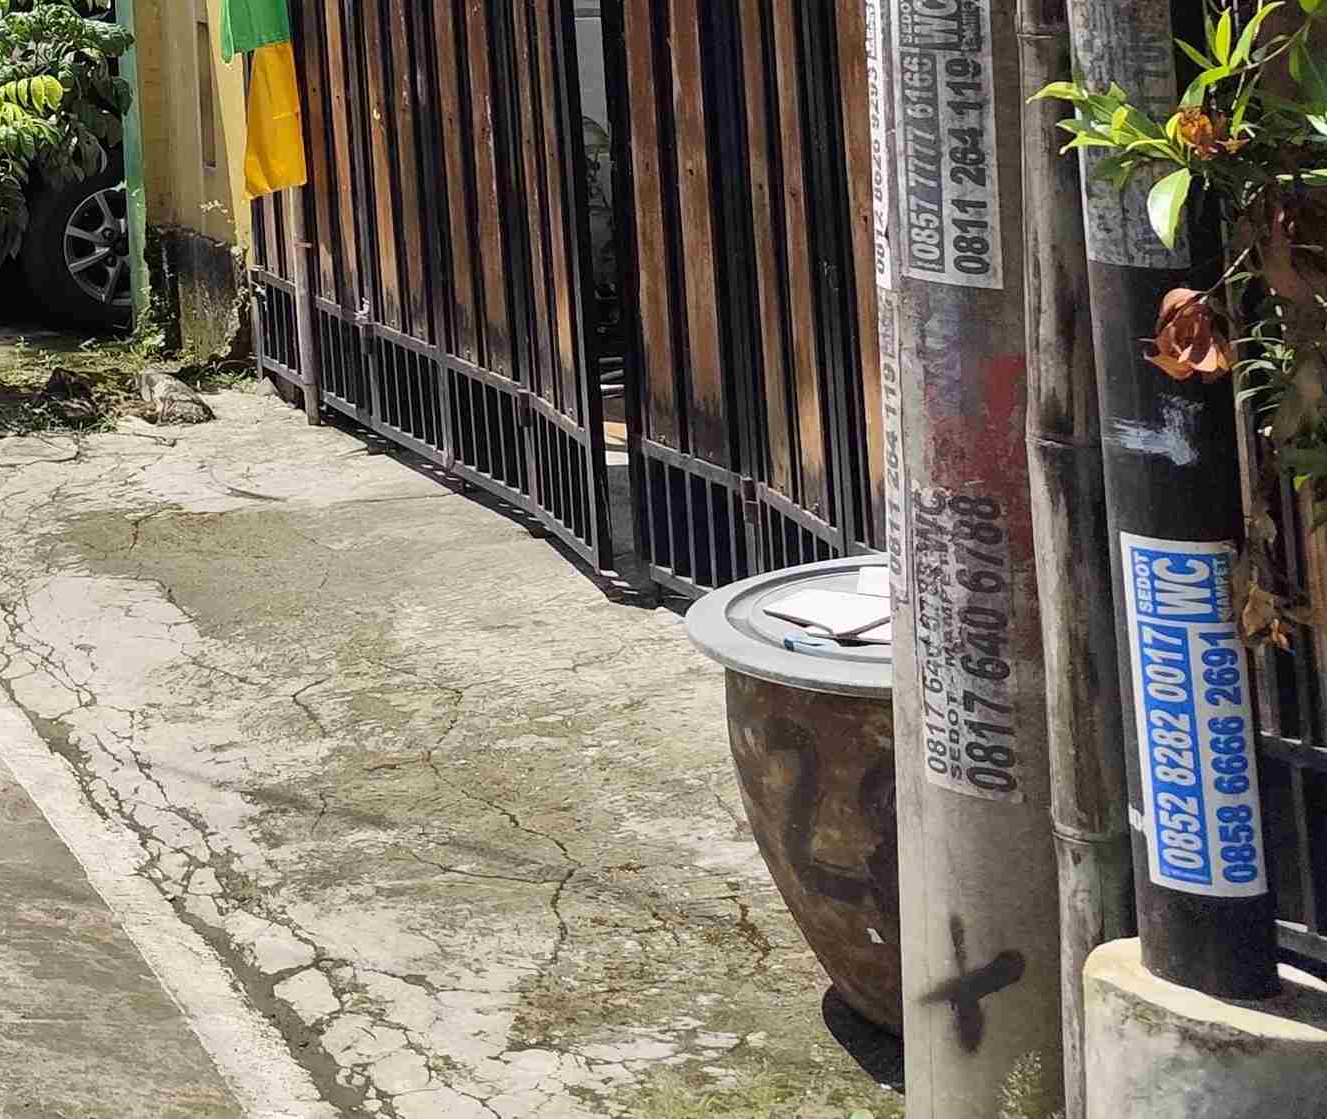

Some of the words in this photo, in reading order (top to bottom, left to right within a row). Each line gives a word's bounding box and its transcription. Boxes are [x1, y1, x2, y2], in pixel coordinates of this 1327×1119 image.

[945, 58, 983, 116] 119
[905, 126, 938, 187] 7777
[948, 128, 986, 188] 264
[910, 195, 940, 260] 0857
[951, 199, 990, 275] 0811
[882, 362, 896, 418] 119
[949, 496, 1006, 593] 6788
[1134, 551, 1154, 614] SEDOT
[1152, 557, 1213, 616] WC
[1212, 557, 1234, 621] MAMPET
[958, 607, 1011, 680] 640
[1142, 625, 1188, 703] 0017
[1199, 631, 1242, 706] 2691
[925, 700, 948, 774] 0817
[946, 691, 963, 780] SEDOT
[963, 689, 1017, 792] 0817
[1148, 708, 1196, 787] 8282
[1208, 716, 1250, 794] 6666
[1156, 791, 1205, 870] 0852
[1216, 803, 1258, 884] 0858
